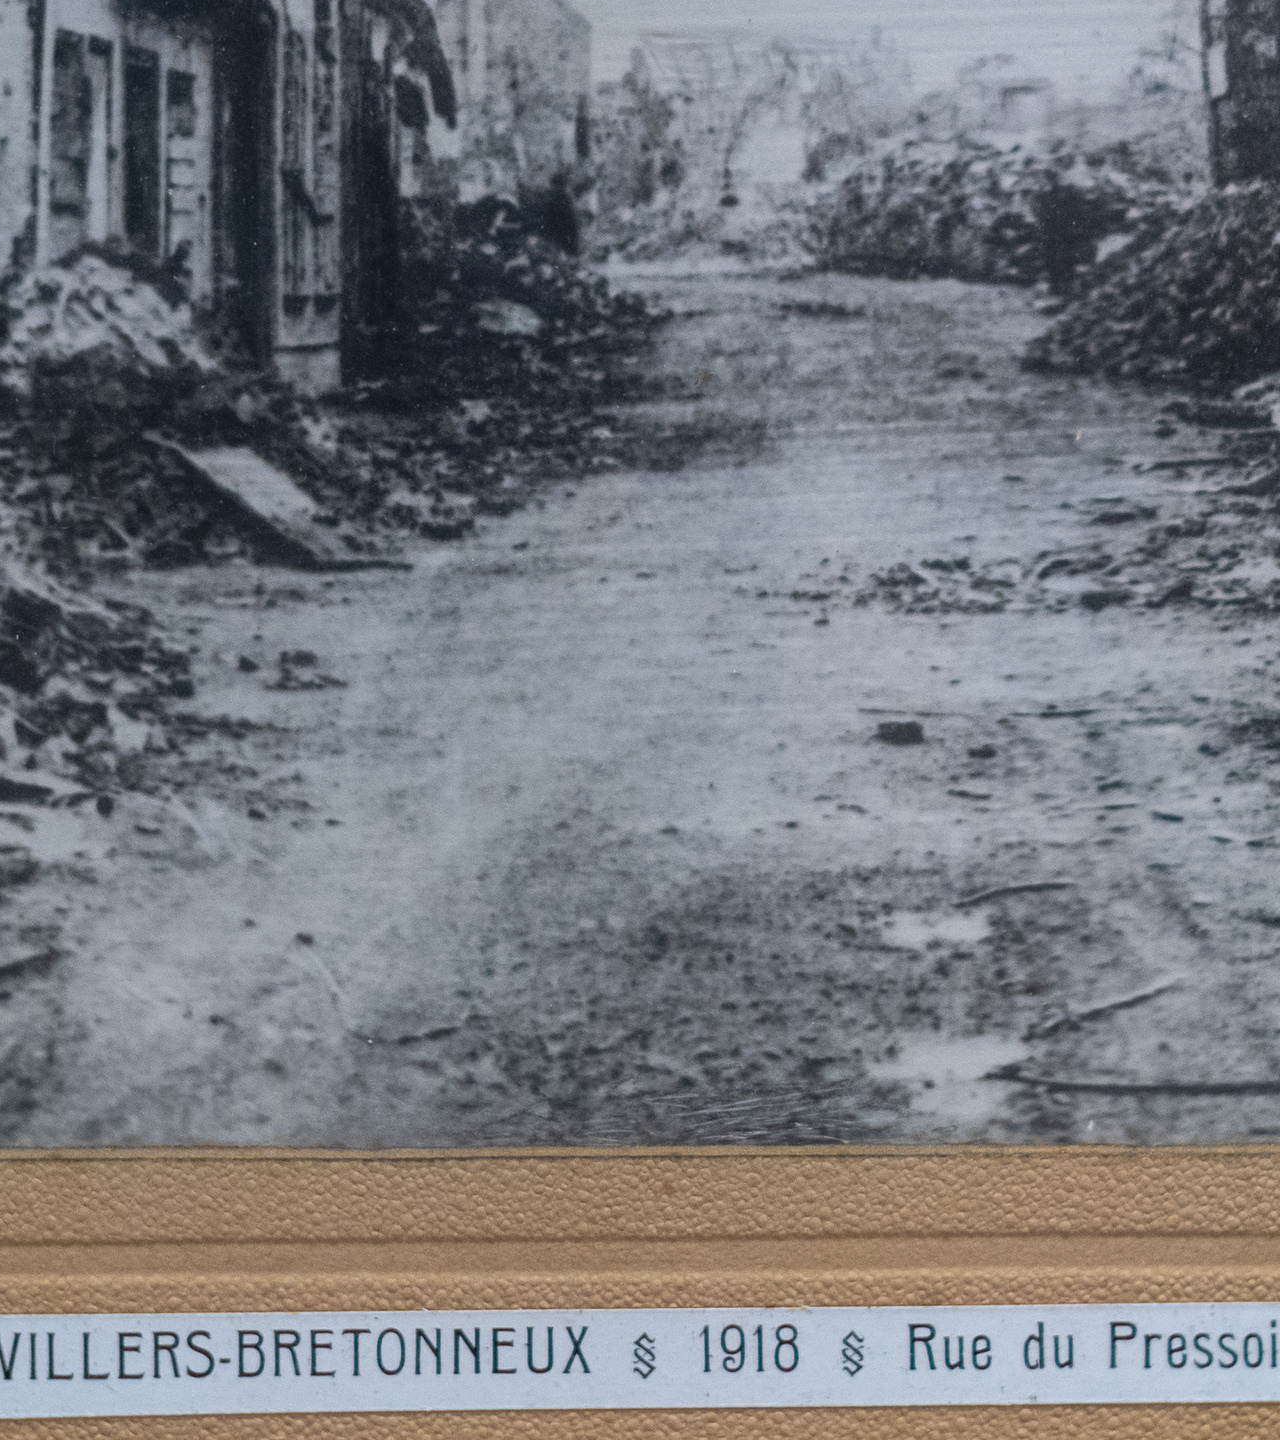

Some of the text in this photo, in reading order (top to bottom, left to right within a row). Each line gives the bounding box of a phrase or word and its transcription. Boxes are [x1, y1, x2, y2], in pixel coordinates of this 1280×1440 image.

[701, 1323, 801, 1374] 1918
[907, 1322, 993, 1372] Rue
[1022, 1321, 1075, 1371] du
